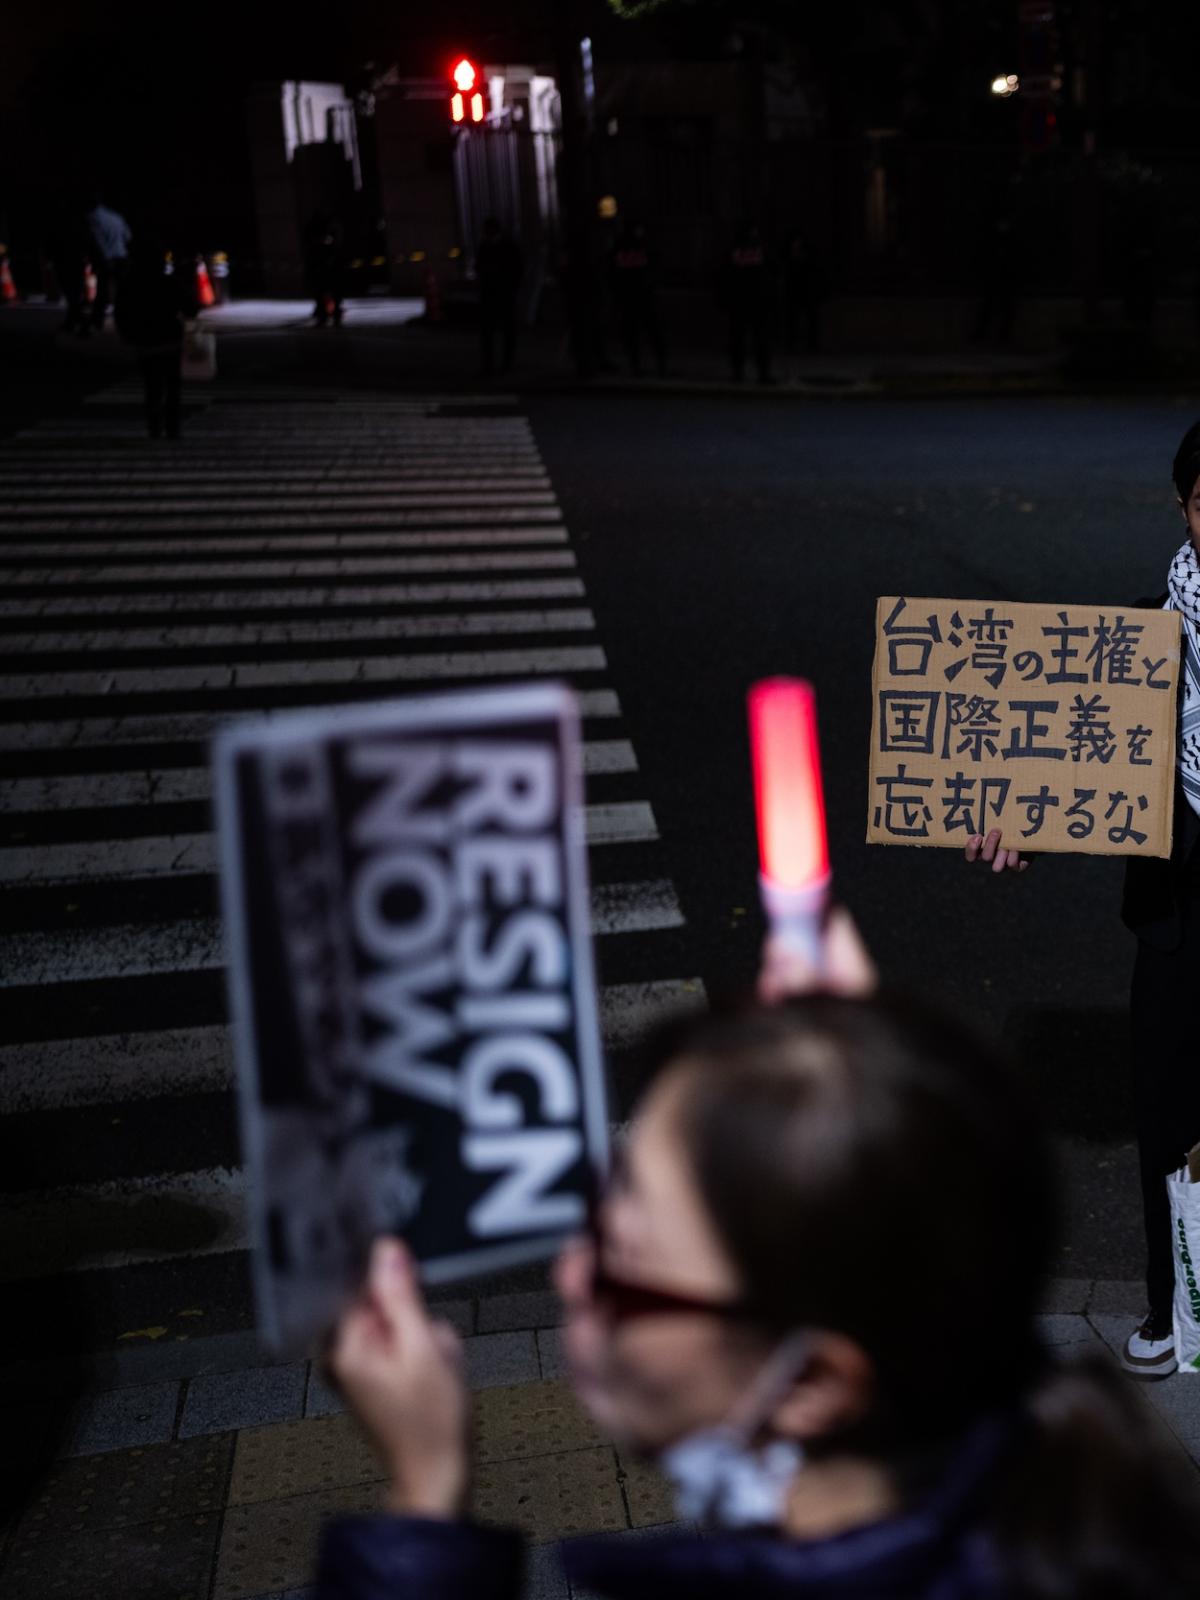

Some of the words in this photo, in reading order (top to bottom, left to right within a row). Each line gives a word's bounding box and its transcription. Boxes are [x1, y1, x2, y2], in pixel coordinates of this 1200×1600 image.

[882, 595, 1171, 690] 台湾の主権と
[879, 690, 1153, 766] 国際正義を
[873, 764, 1149, 846] 忘却するな
[343, 742, 463, 1110] NOW
[452, 740, 590, 1240] RESIGN
